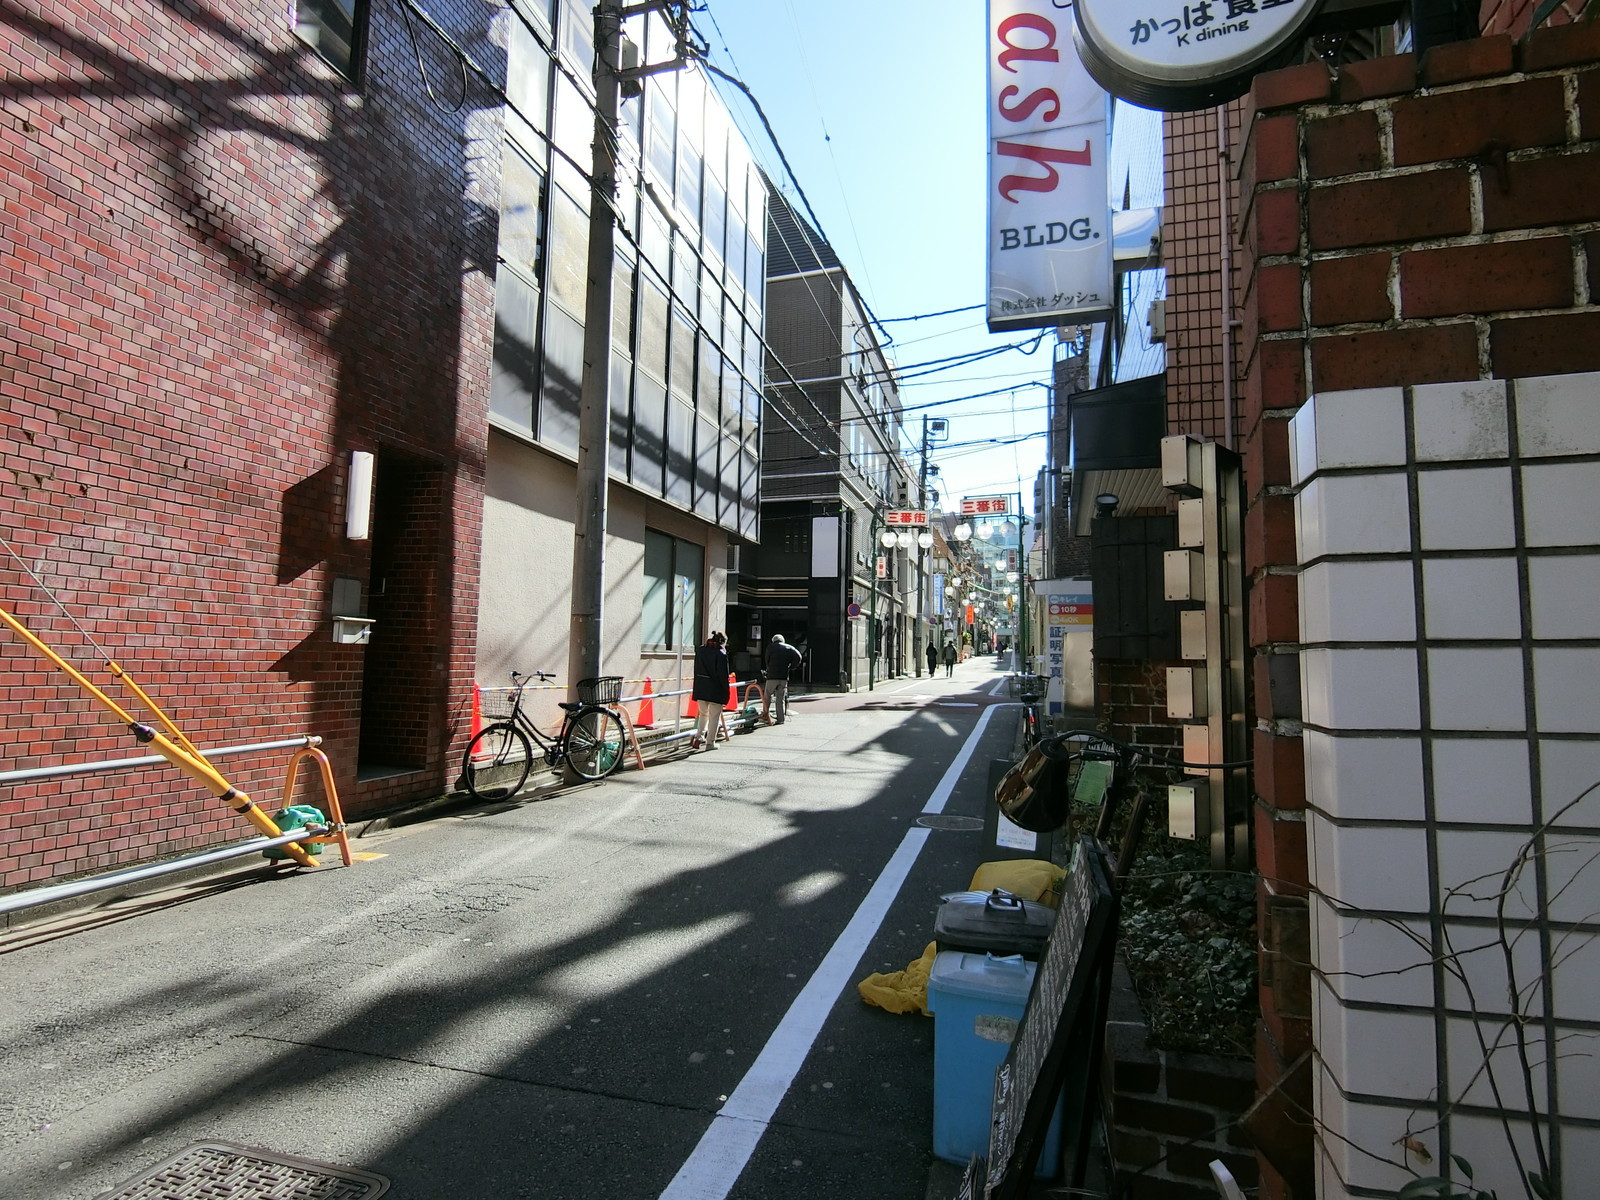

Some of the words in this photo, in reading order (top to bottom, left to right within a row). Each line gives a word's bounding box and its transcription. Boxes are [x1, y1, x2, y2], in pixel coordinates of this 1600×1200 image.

[1176, 33, 1190, 47] K
[1196, 20, 1250, 42] dining
[1000, 217, 1100, 251] BLDG.
[1001, 295, 1047, 312] 株式会社
[1050, 291, 1100, 307] ダッシュ
[961, 499, 1006, 514] 三番街
[887, 511, 926, 524] 三番街
[1060, 606, 1077, 614] 10秒
[1050, 627, 1062, 677] 証明写真
